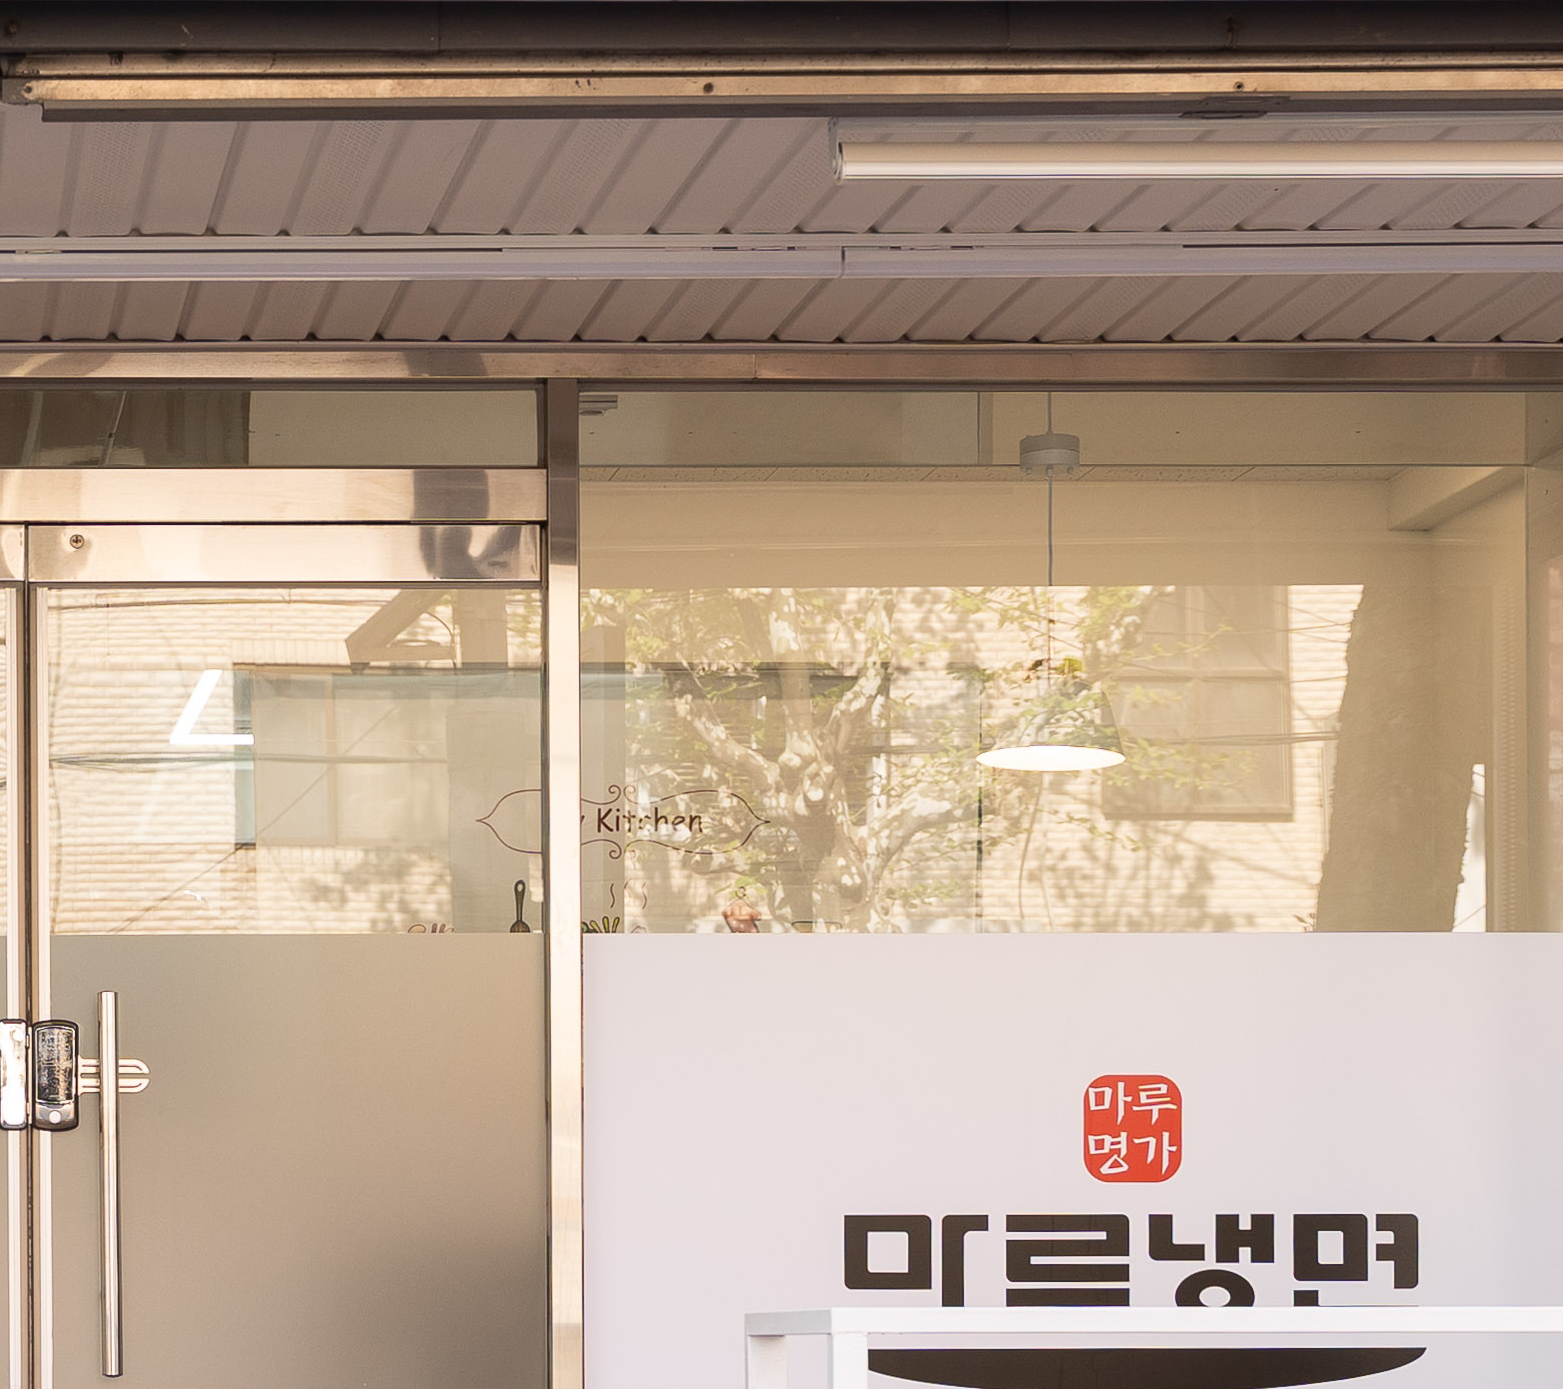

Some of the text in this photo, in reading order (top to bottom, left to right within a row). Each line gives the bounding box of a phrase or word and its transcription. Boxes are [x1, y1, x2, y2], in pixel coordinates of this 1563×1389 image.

[596, 806, 704, 833] Kitchen
[1086, 1080, 1178, 1126] 마루
[1086, 1130, 1178, 1177] 명가
